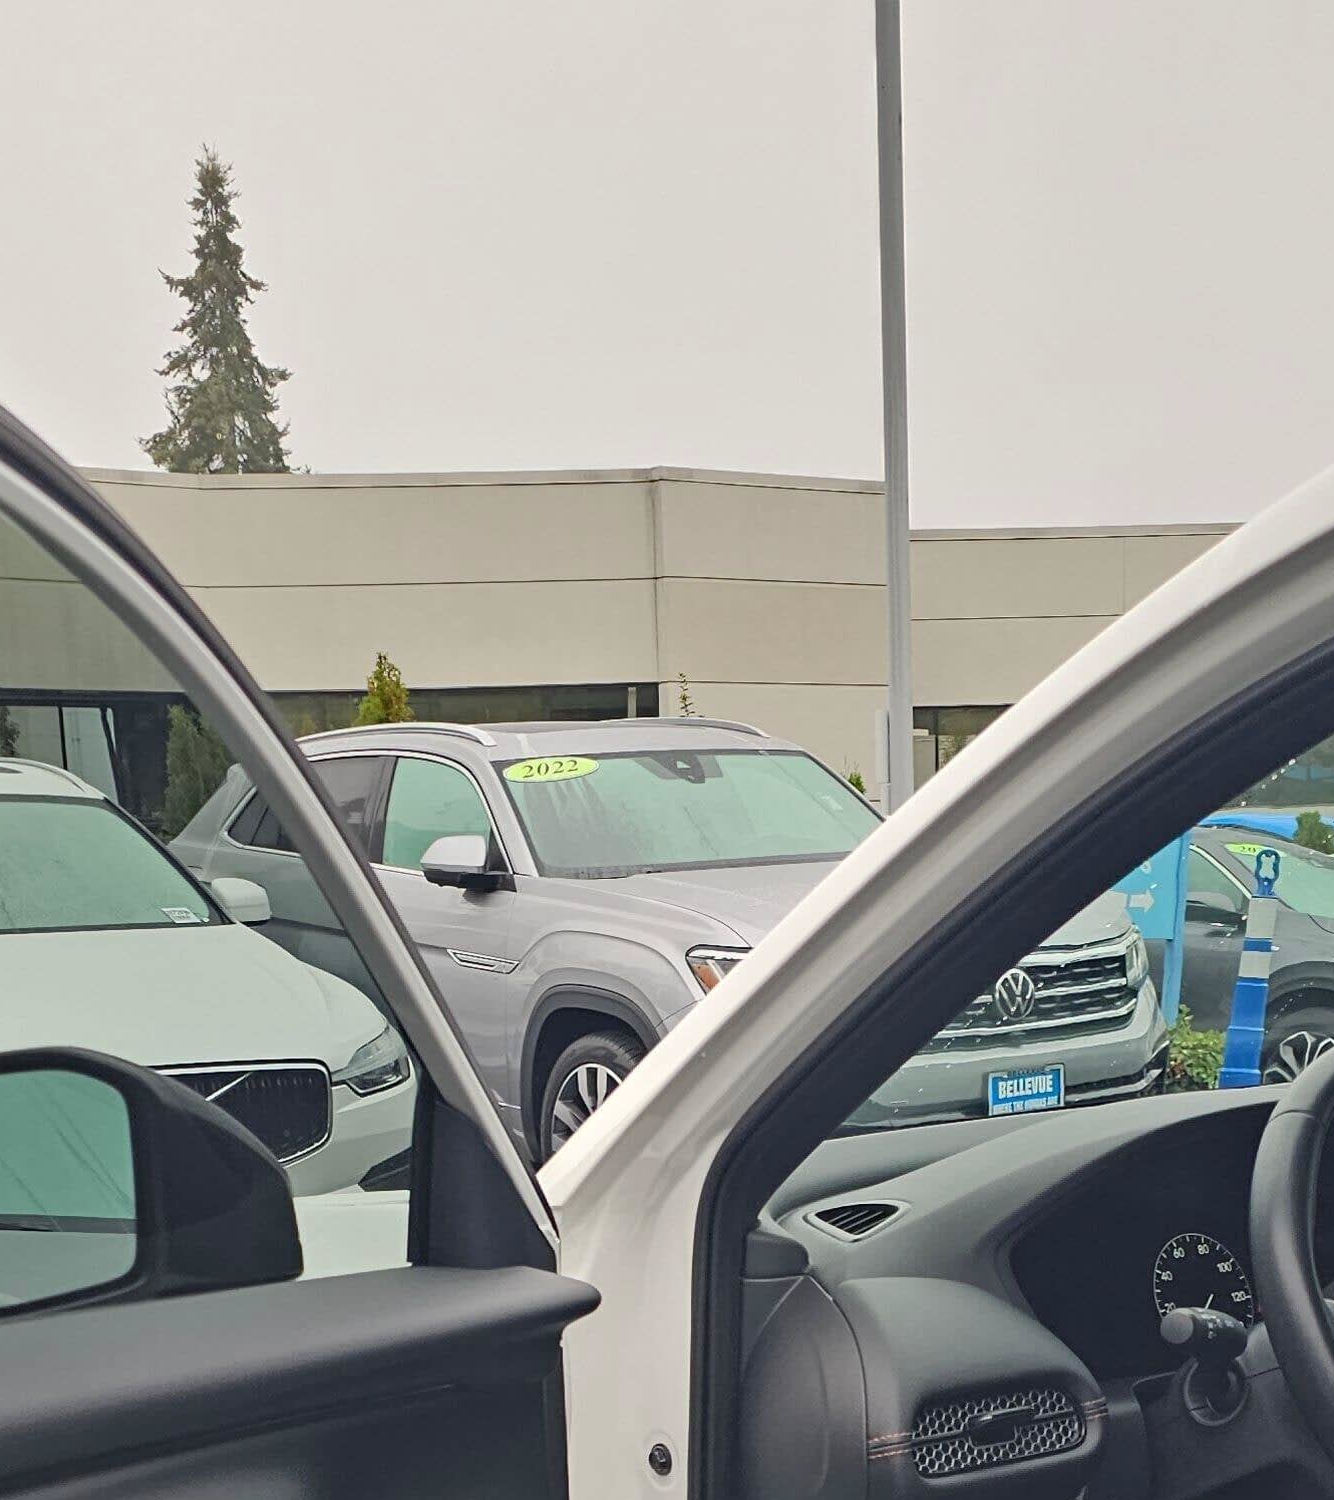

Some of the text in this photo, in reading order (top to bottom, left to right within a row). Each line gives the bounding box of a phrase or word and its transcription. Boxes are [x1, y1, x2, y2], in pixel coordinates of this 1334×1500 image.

[522, 759, 578, 779] 2022
[997, 1074, 1053, 1100] BELLEVUE
[1173, 1247, 1185, 1259] 60
[1197, 1244, 1209, 1255] 80
[1217, 1262, 1232, 1272] 100
[1161, 1271, 1173, 1281] 40
[1231, 1291, 1246, 1302] 120
